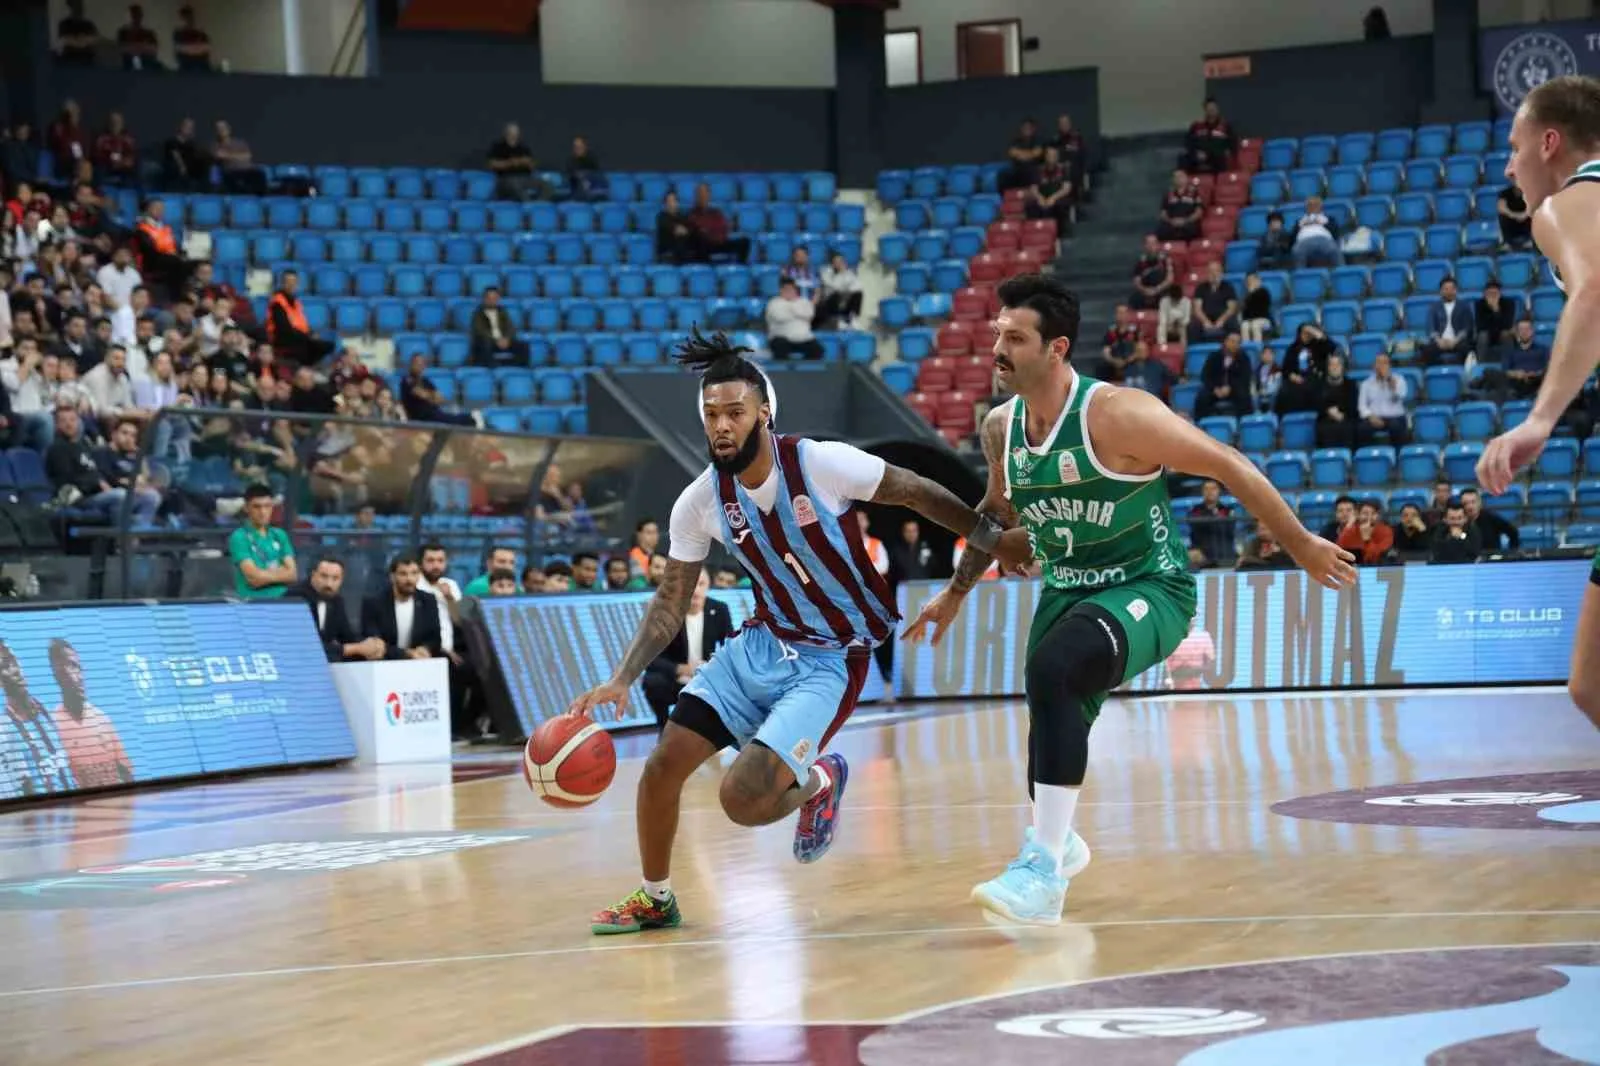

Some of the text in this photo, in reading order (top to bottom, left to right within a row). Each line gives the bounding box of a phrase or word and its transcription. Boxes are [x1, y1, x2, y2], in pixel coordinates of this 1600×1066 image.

[1054, 527, 1074, 557] 7
[784, 552, 810, 584] 1
[1500, 607, 1562, 622] CLUB
[204, 652, 280, 683] CLUB
